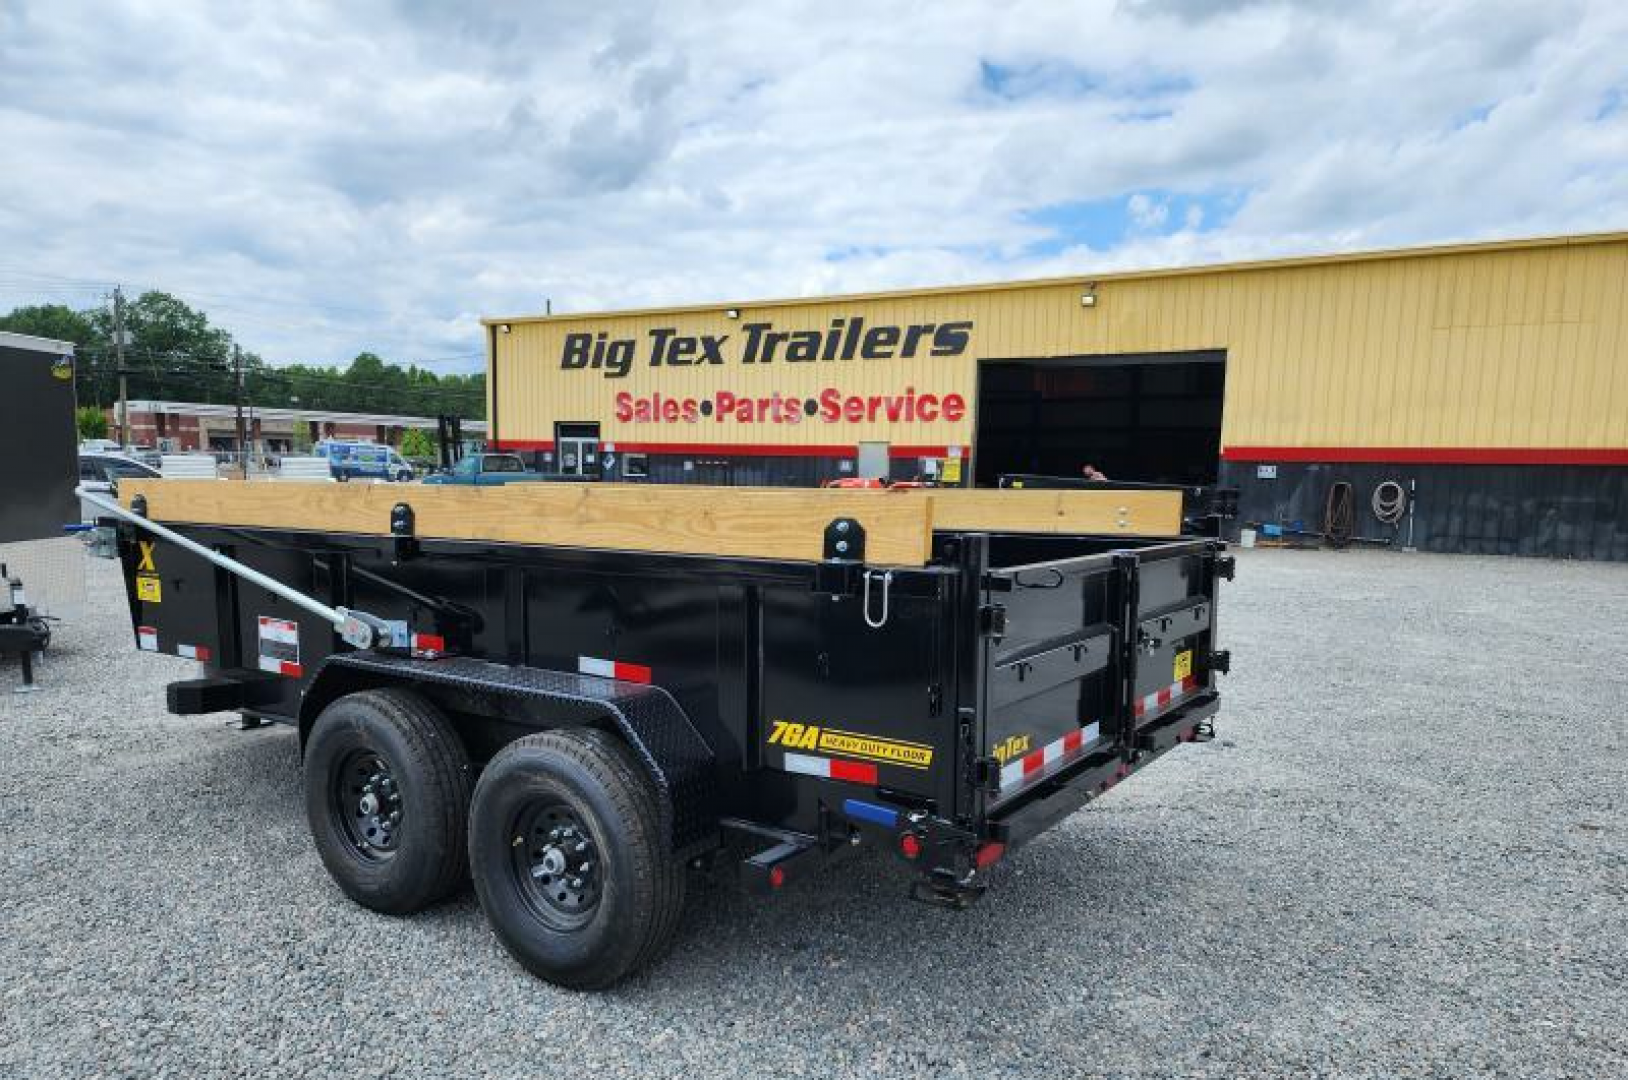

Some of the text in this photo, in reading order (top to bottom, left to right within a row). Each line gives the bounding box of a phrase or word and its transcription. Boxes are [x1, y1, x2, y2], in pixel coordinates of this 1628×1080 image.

[561, 317, 974, 378] Big Tex Trailers
[615, 386, 966, 423] Sales Parts Service
[825, 735, 860, 750] HEAVY
[860, 741, 888, 756] DUTY
[891, 748, 927, 762] FLOOR
